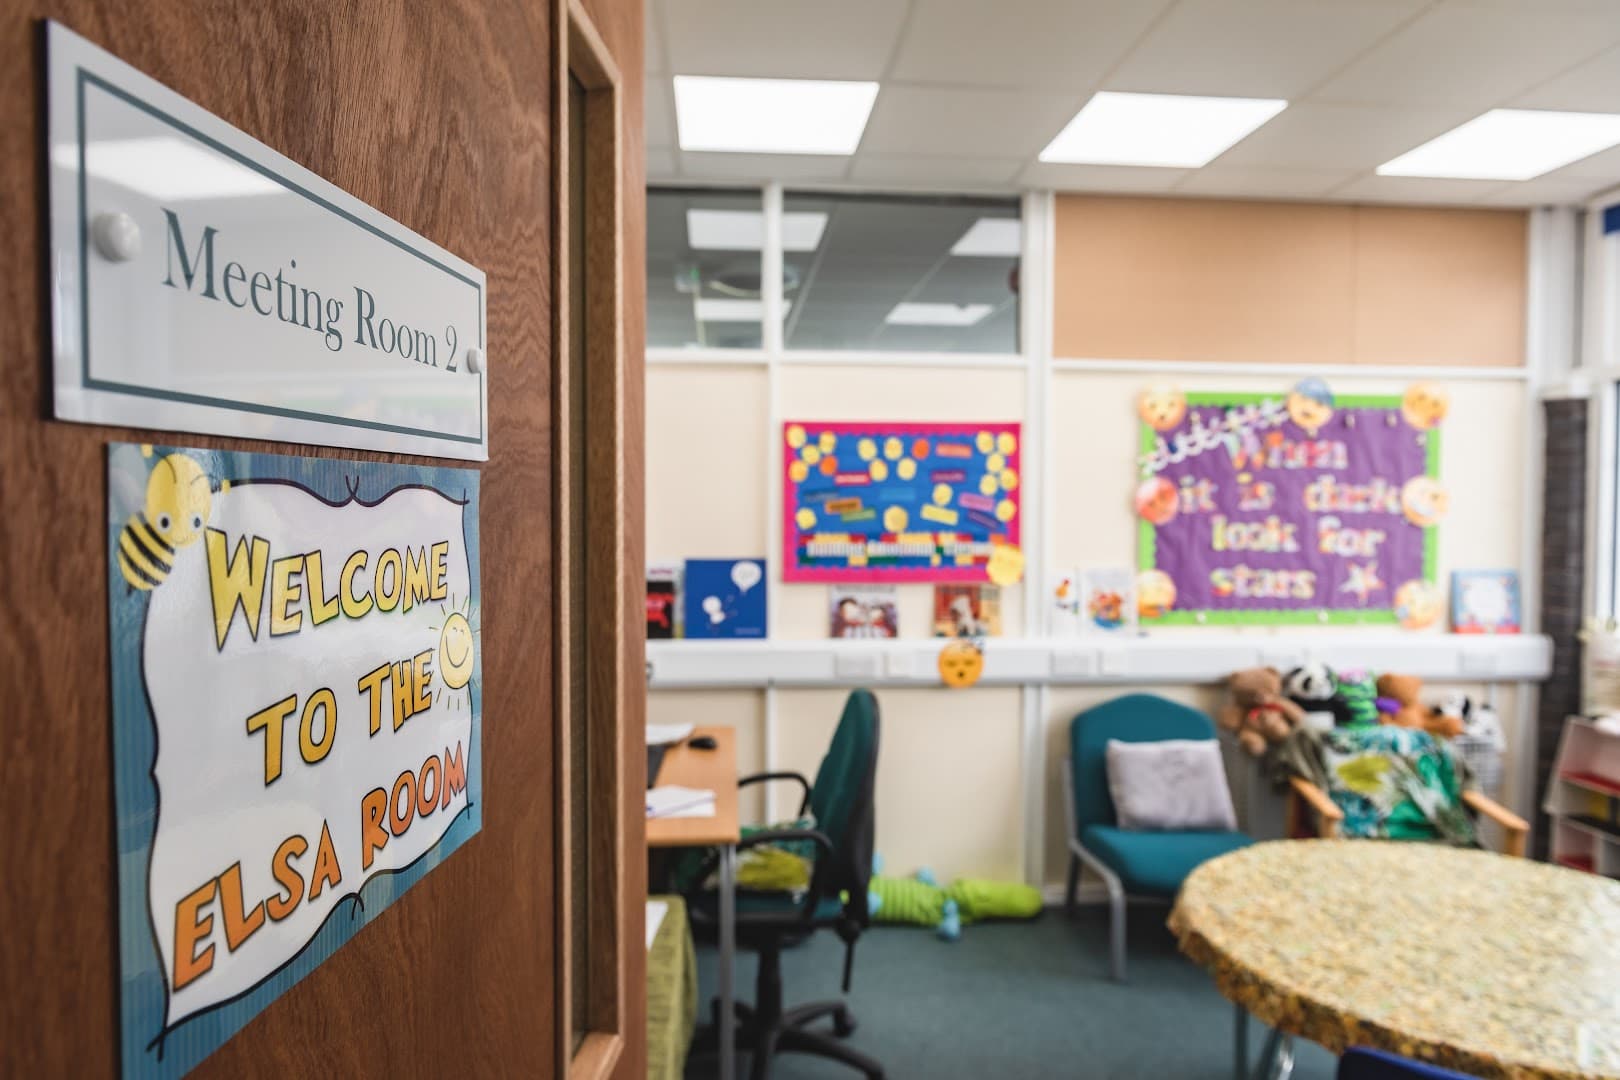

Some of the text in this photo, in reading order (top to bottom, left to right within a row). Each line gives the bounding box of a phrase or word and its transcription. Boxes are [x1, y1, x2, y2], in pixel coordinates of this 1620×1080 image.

[161, 207, 458, 373] Meeting Room 2
[204, 526, 449, 653] WELCOME
[1209, 564, 1317, 600] stars
[1211, 514, 1387, 557] look for
[246, 647, 436, 787] TO THE
[172, 739, 467, 994] ELSA ROOM
